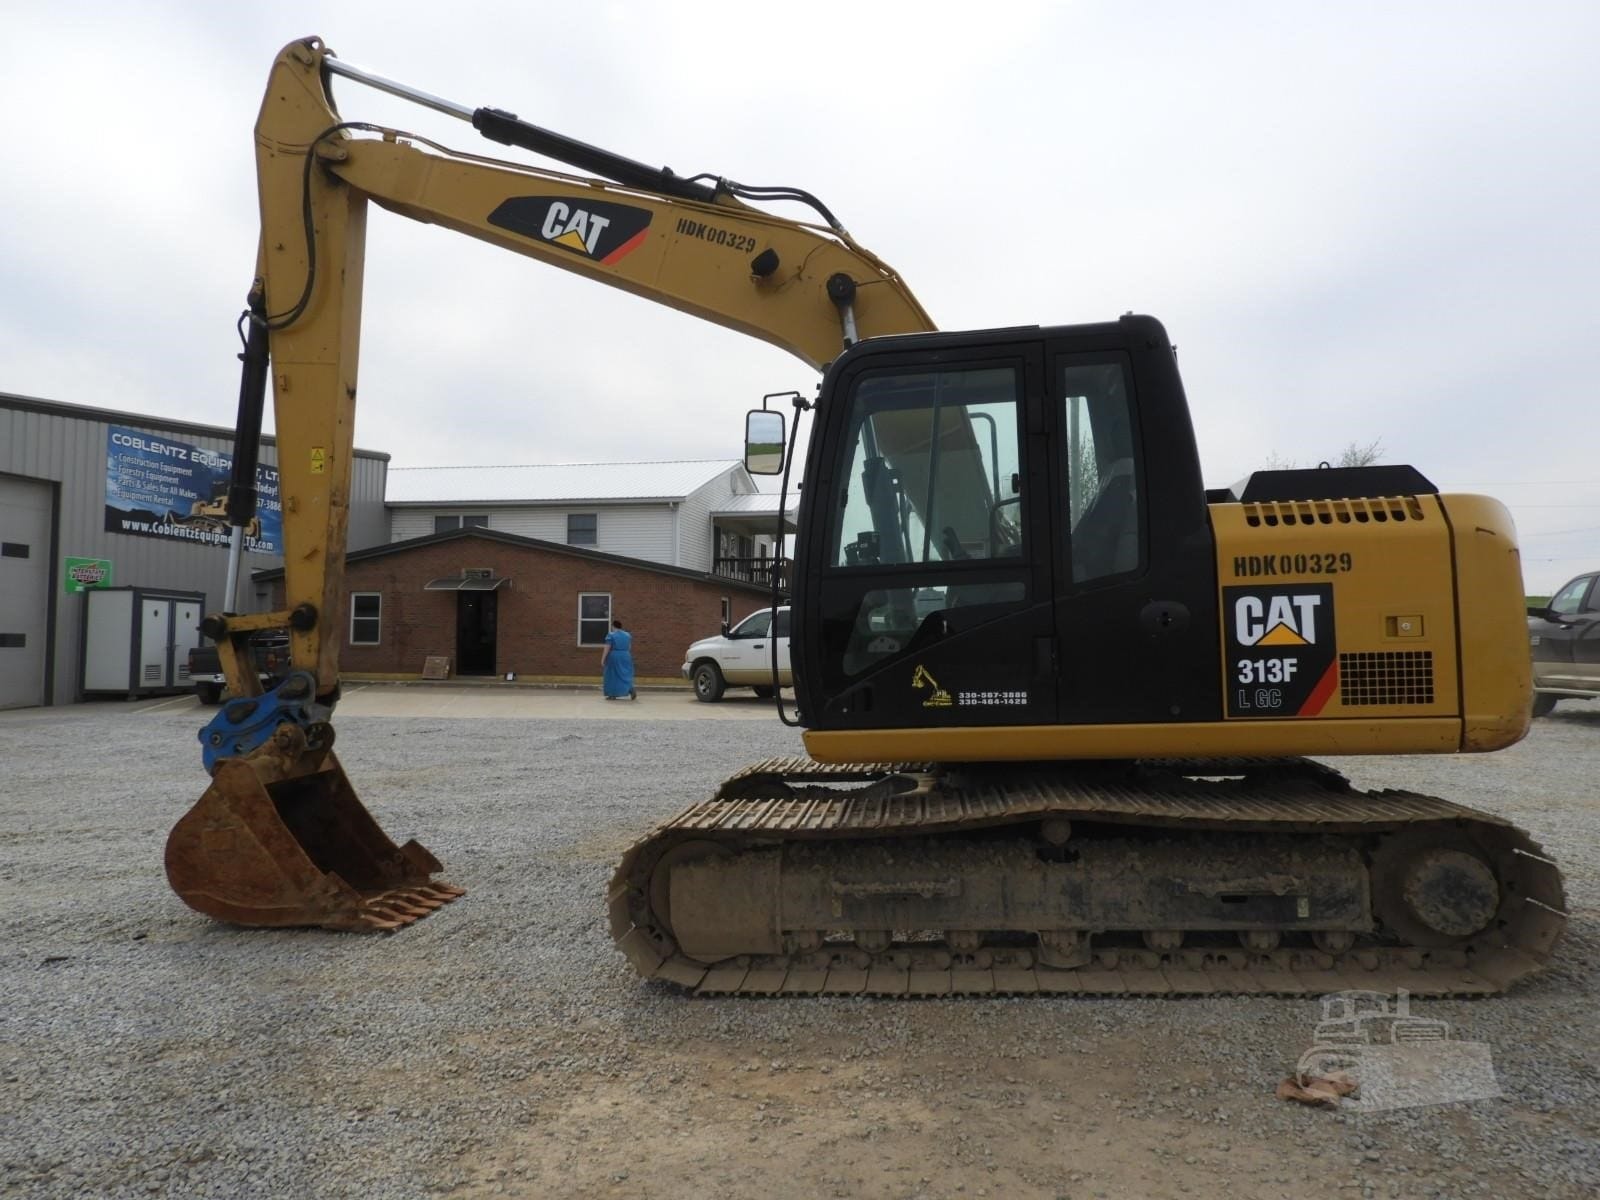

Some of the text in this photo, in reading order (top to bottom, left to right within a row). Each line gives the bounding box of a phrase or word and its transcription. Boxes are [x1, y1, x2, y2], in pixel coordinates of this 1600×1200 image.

[541, 201, 610, 255] CAT
[676, 217, 756, 253] HDK00329
[112, 433, 187, 460] COBLENTZ
[265, 470, 279, 482] LT
[119, 453, 193, 477] Construction Equipment
[118, 464, 179, 485] Forestry Equipment
[117, 487, 174, 506] Equipment Rental
[118, 478, 136, 488] Parts
[142, 481, 159, 492] Sales
[160, 485, 169, 493] for
[169, 486, 177, 495] All
[178, 487, 198, 499] Makes
[121, 519, 274, 550] www.CoblentzEquipmeTD.com
[1233, 553, 1352, 577] HDK00329
[1235, 594, 1321, 647] CAT
[1237, 658, 1298, 684] 313F
[1238, 688, 1282, 708] L GC
